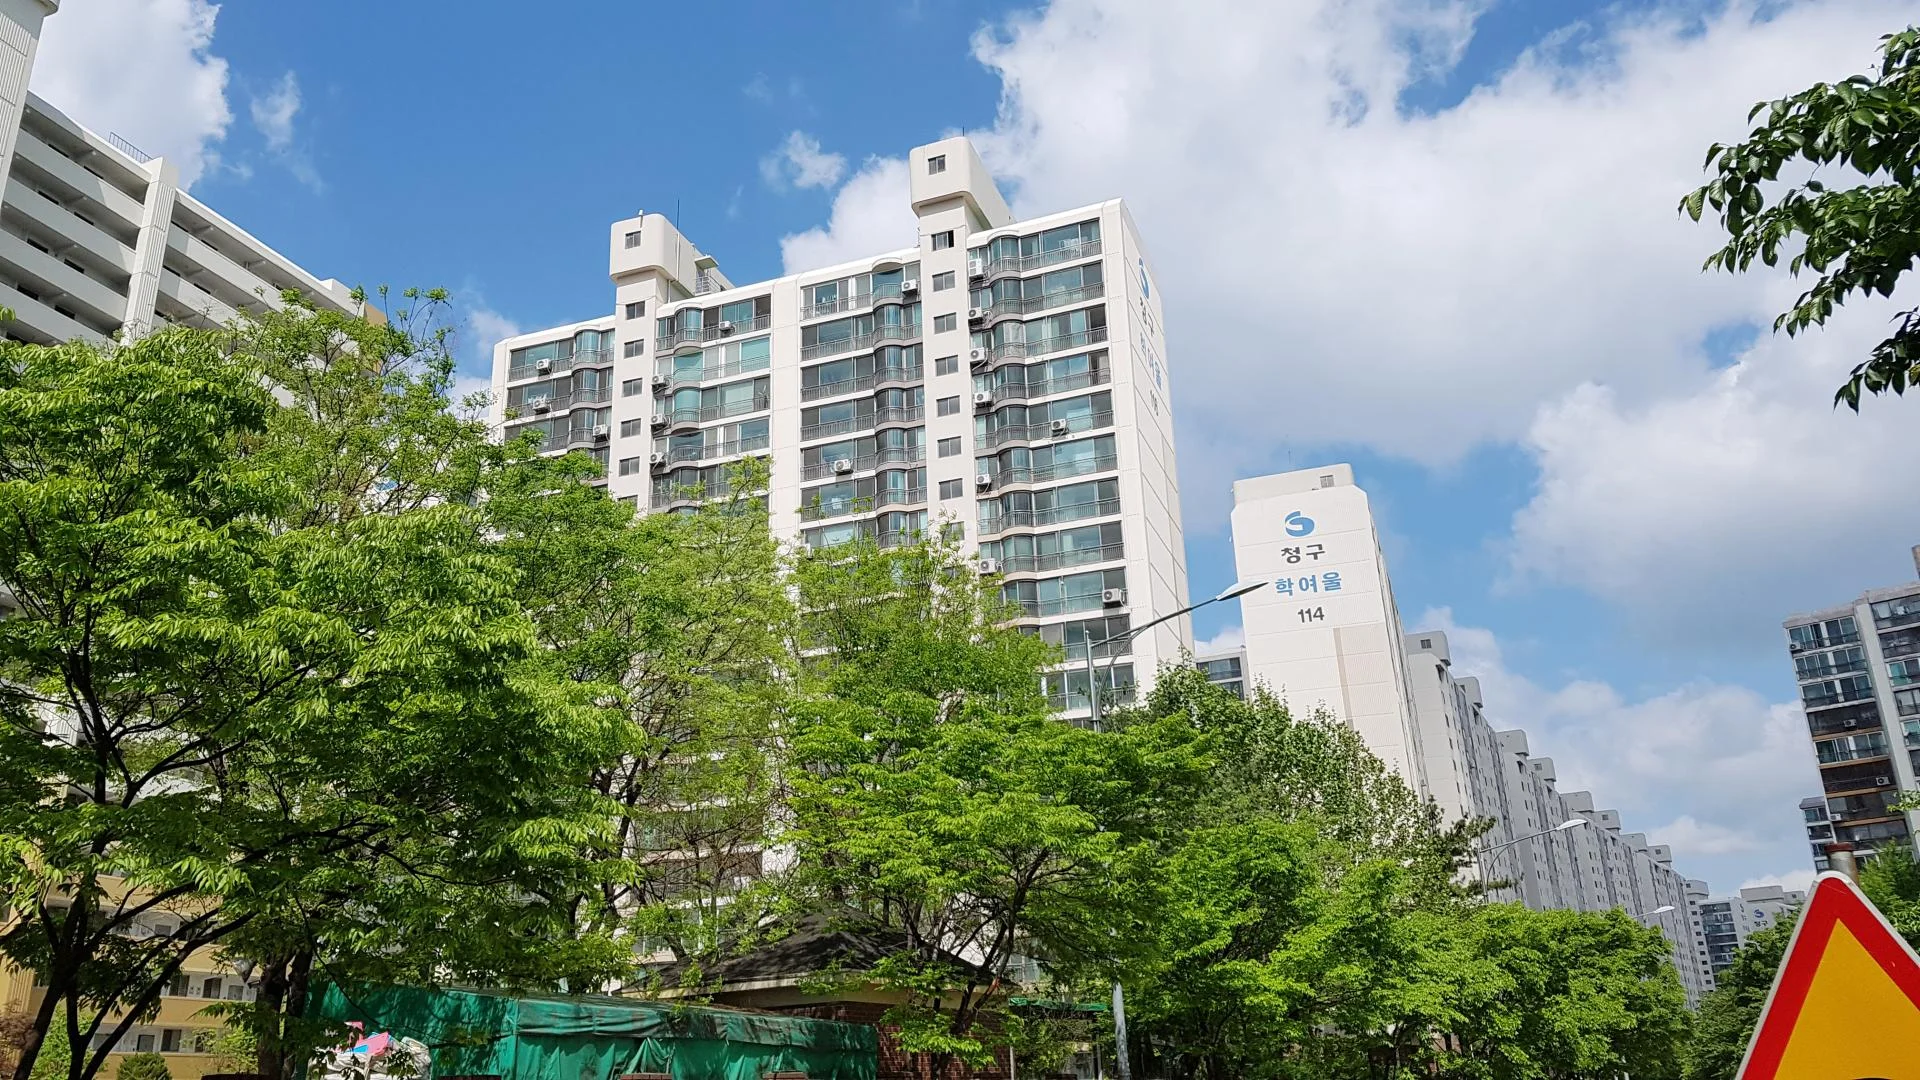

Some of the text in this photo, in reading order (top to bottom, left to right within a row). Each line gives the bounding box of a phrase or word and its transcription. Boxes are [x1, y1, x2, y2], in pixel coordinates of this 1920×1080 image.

[1280, 543, 1326, 564] 청구
[1274, 571, 1342, 596] 학여울
[1297, 606, 1325, 624] 114
